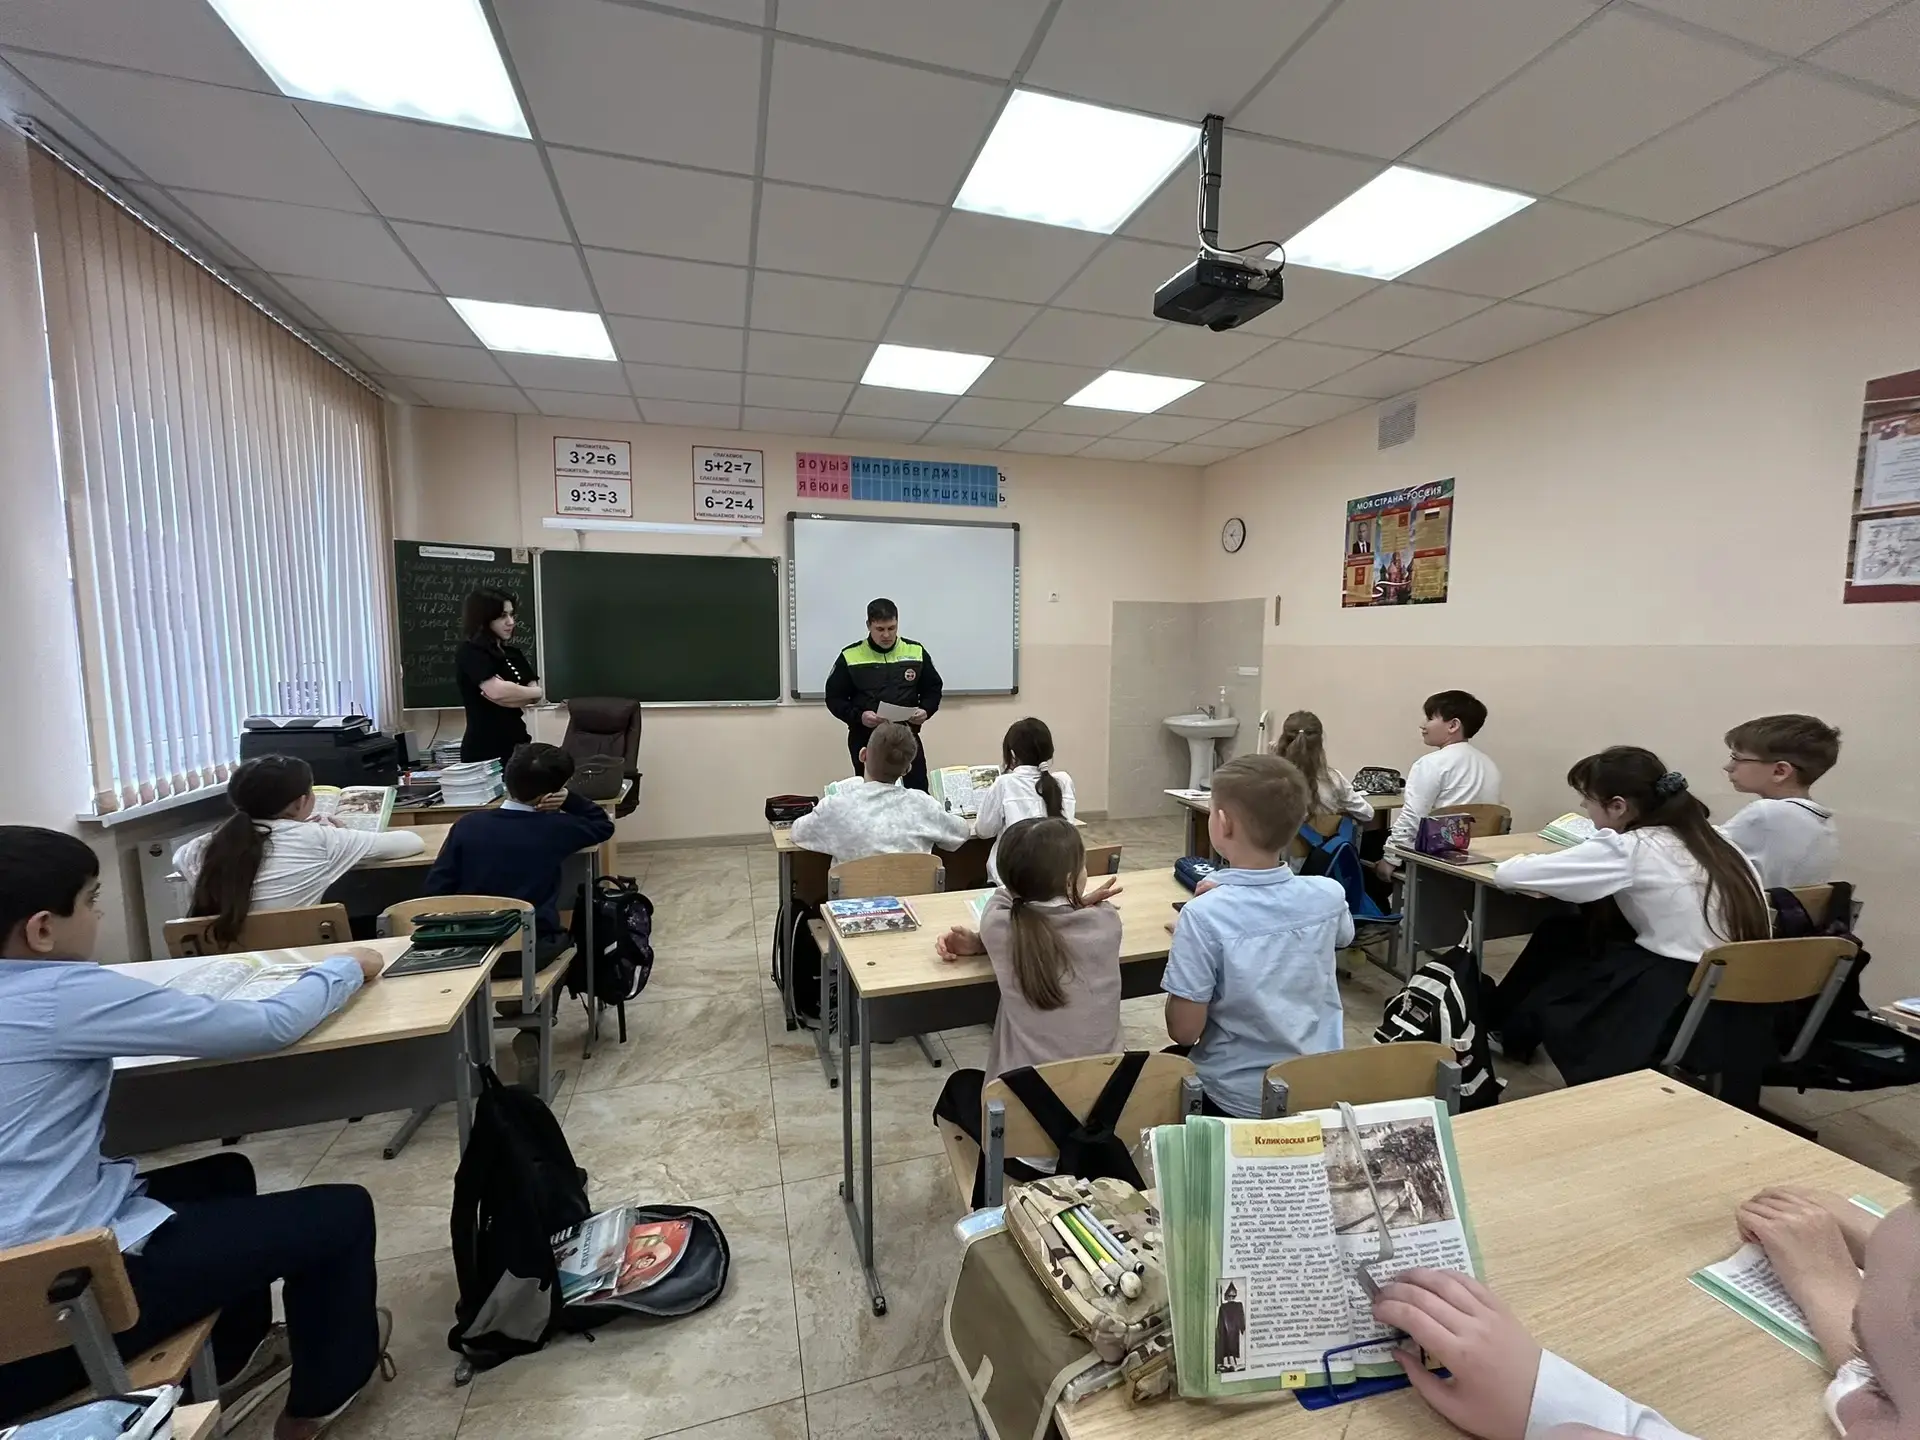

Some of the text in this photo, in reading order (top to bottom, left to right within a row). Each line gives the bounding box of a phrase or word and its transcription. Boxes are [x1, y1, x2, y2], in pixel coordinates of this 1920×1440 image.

[704, 460, 752, 474] 5+2=7
[571, 490, 617, 503] 9:3=3
[1357, 501, 1372, 510] МОЯ
